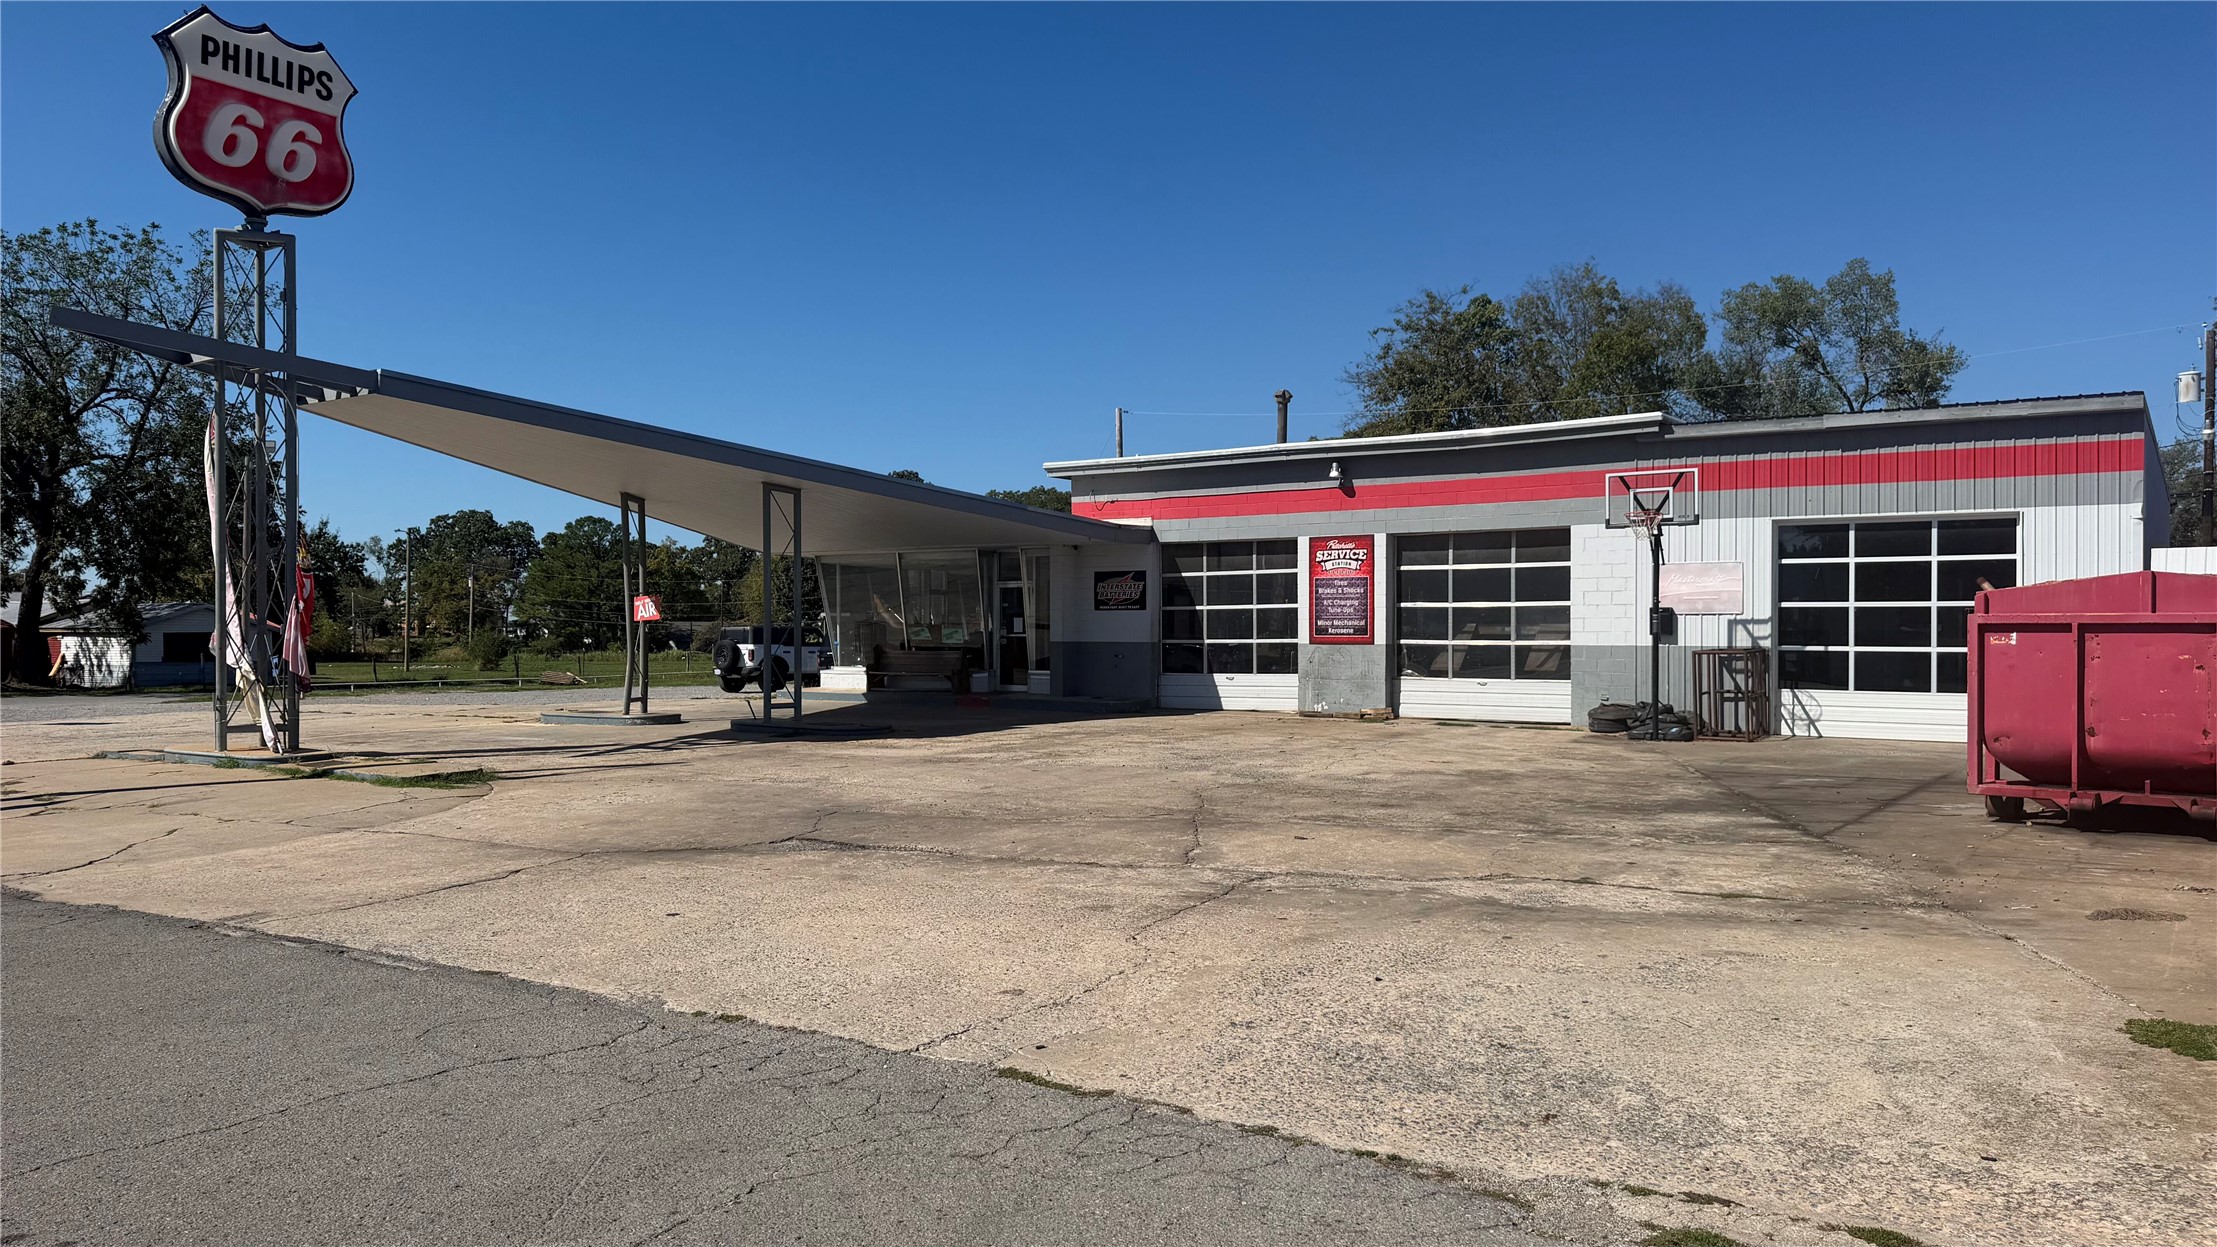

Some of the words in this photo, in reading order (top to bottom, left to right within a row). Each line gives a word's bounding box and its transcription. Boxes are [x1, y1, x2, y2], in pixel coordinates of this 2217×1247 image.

[201, 34, 333, 101] PHILLIPS
[204, 103, 323, 183] 66
[1316, 549, 1367, 561] SERVICE
[1097, 582, 1143, 591] INTERSTATE
[1098, 591, 1140, 599] BATTERIES
[638, 601, 657, 619] AIR
